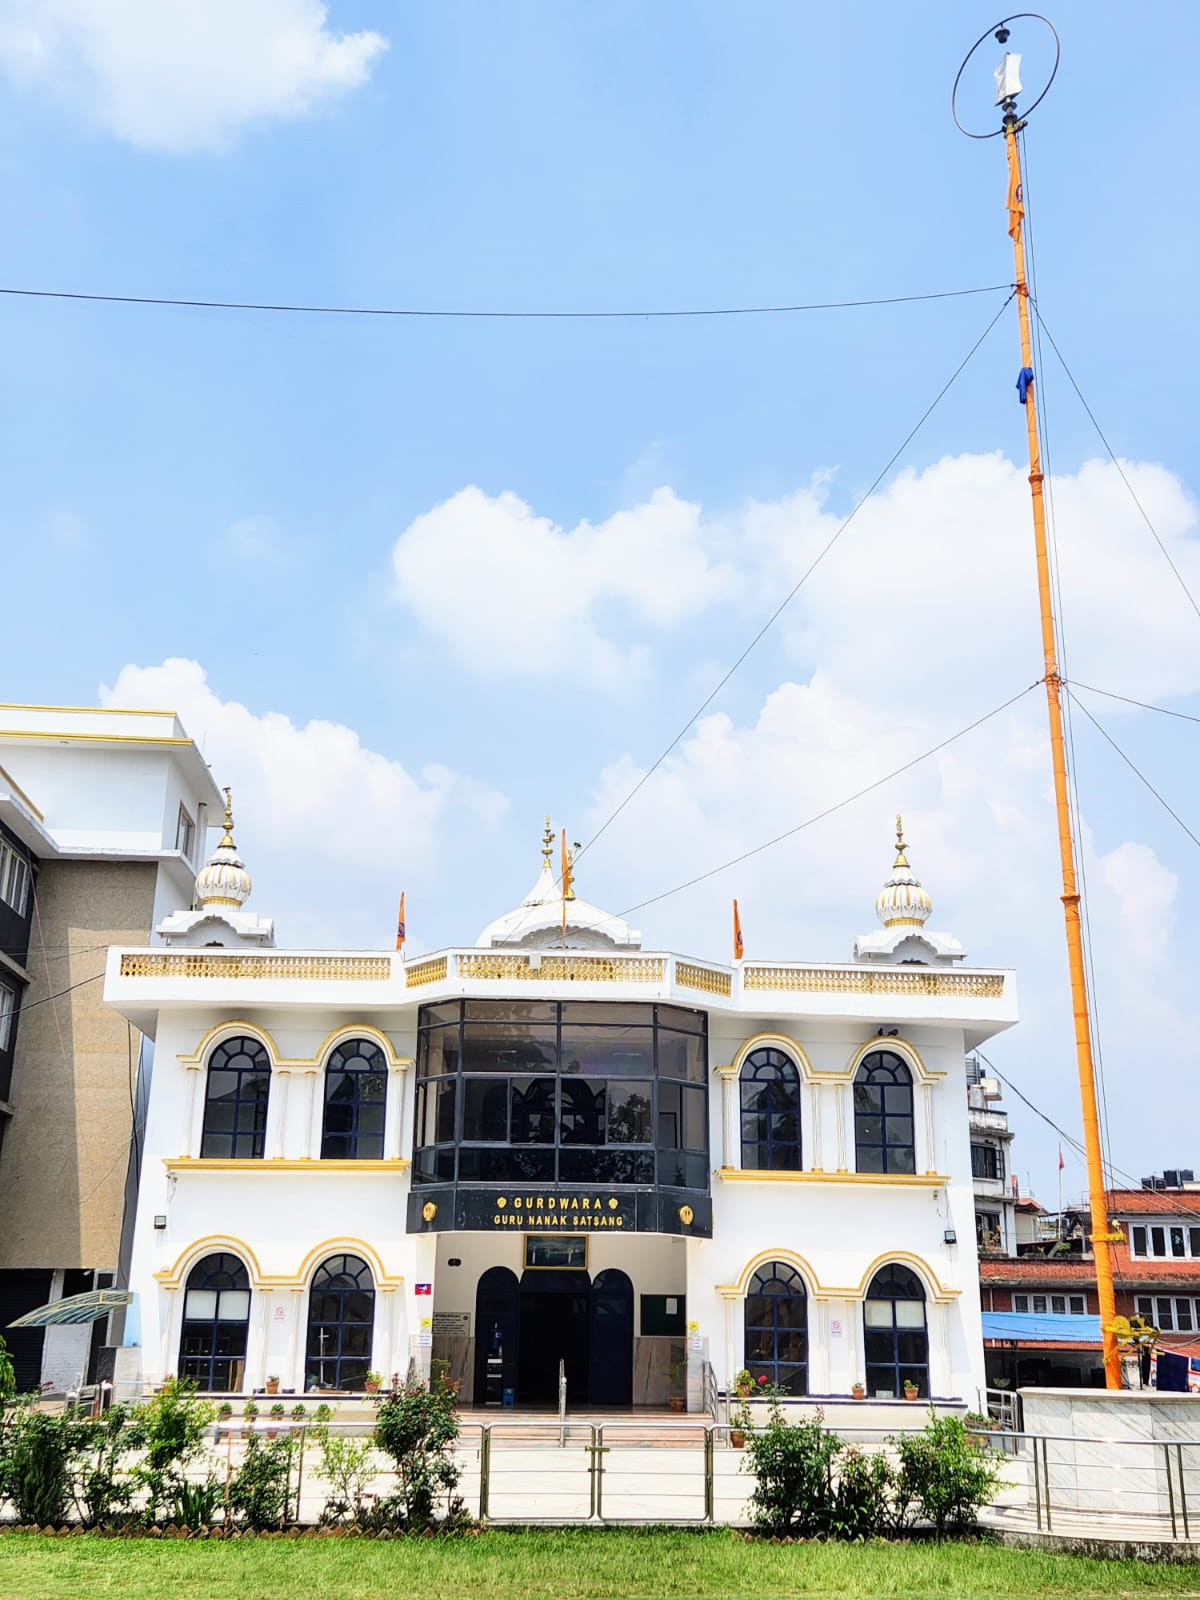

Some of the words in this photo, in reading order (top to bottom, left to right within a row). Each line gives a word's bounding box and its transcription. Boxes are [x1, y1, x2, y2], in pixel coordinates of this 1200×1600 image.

[514, 1197, 602, 1209] GURDWARA
[493, 1214, 524, 1225] GURU
[528, 1215, 567, 1226] NANAK
[573, 1216, 623, 1226] SATSANG
